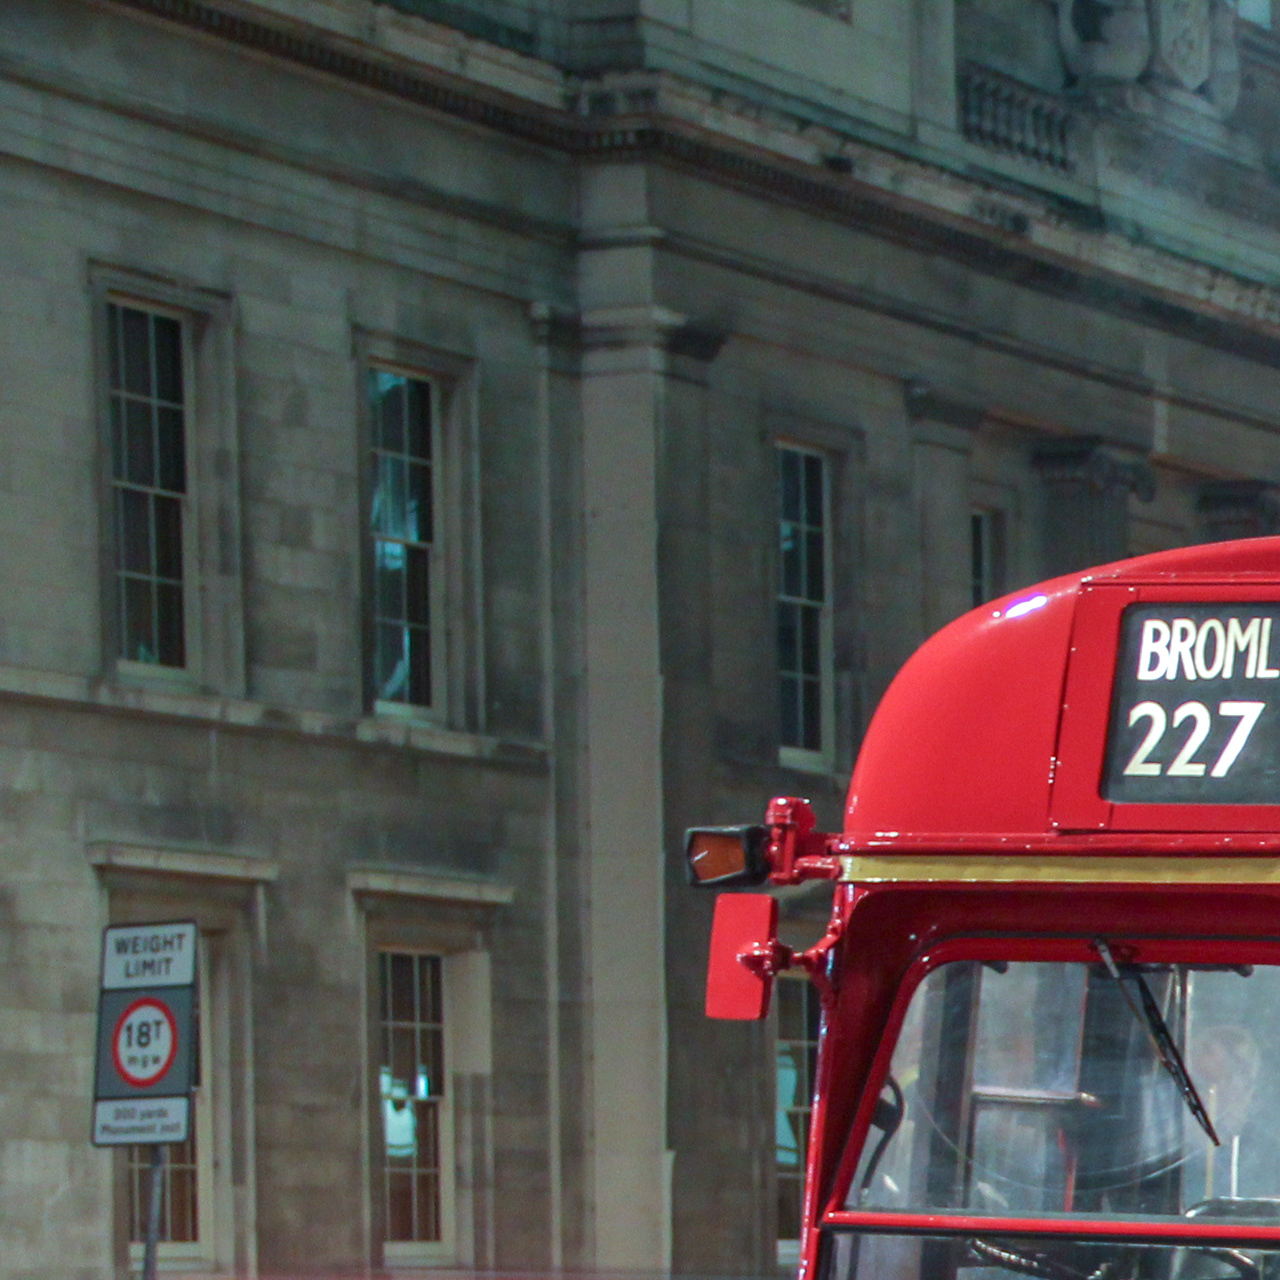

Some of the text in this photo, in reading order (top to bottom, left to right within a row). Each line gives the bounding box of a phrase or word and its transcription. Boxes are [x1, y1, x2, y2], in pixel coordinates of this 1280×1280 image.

[1123, 701, 1266, 778] 227
[114, 933, 186, 954] WEIGHT
[125, 957, 174, 978] LIMIT
